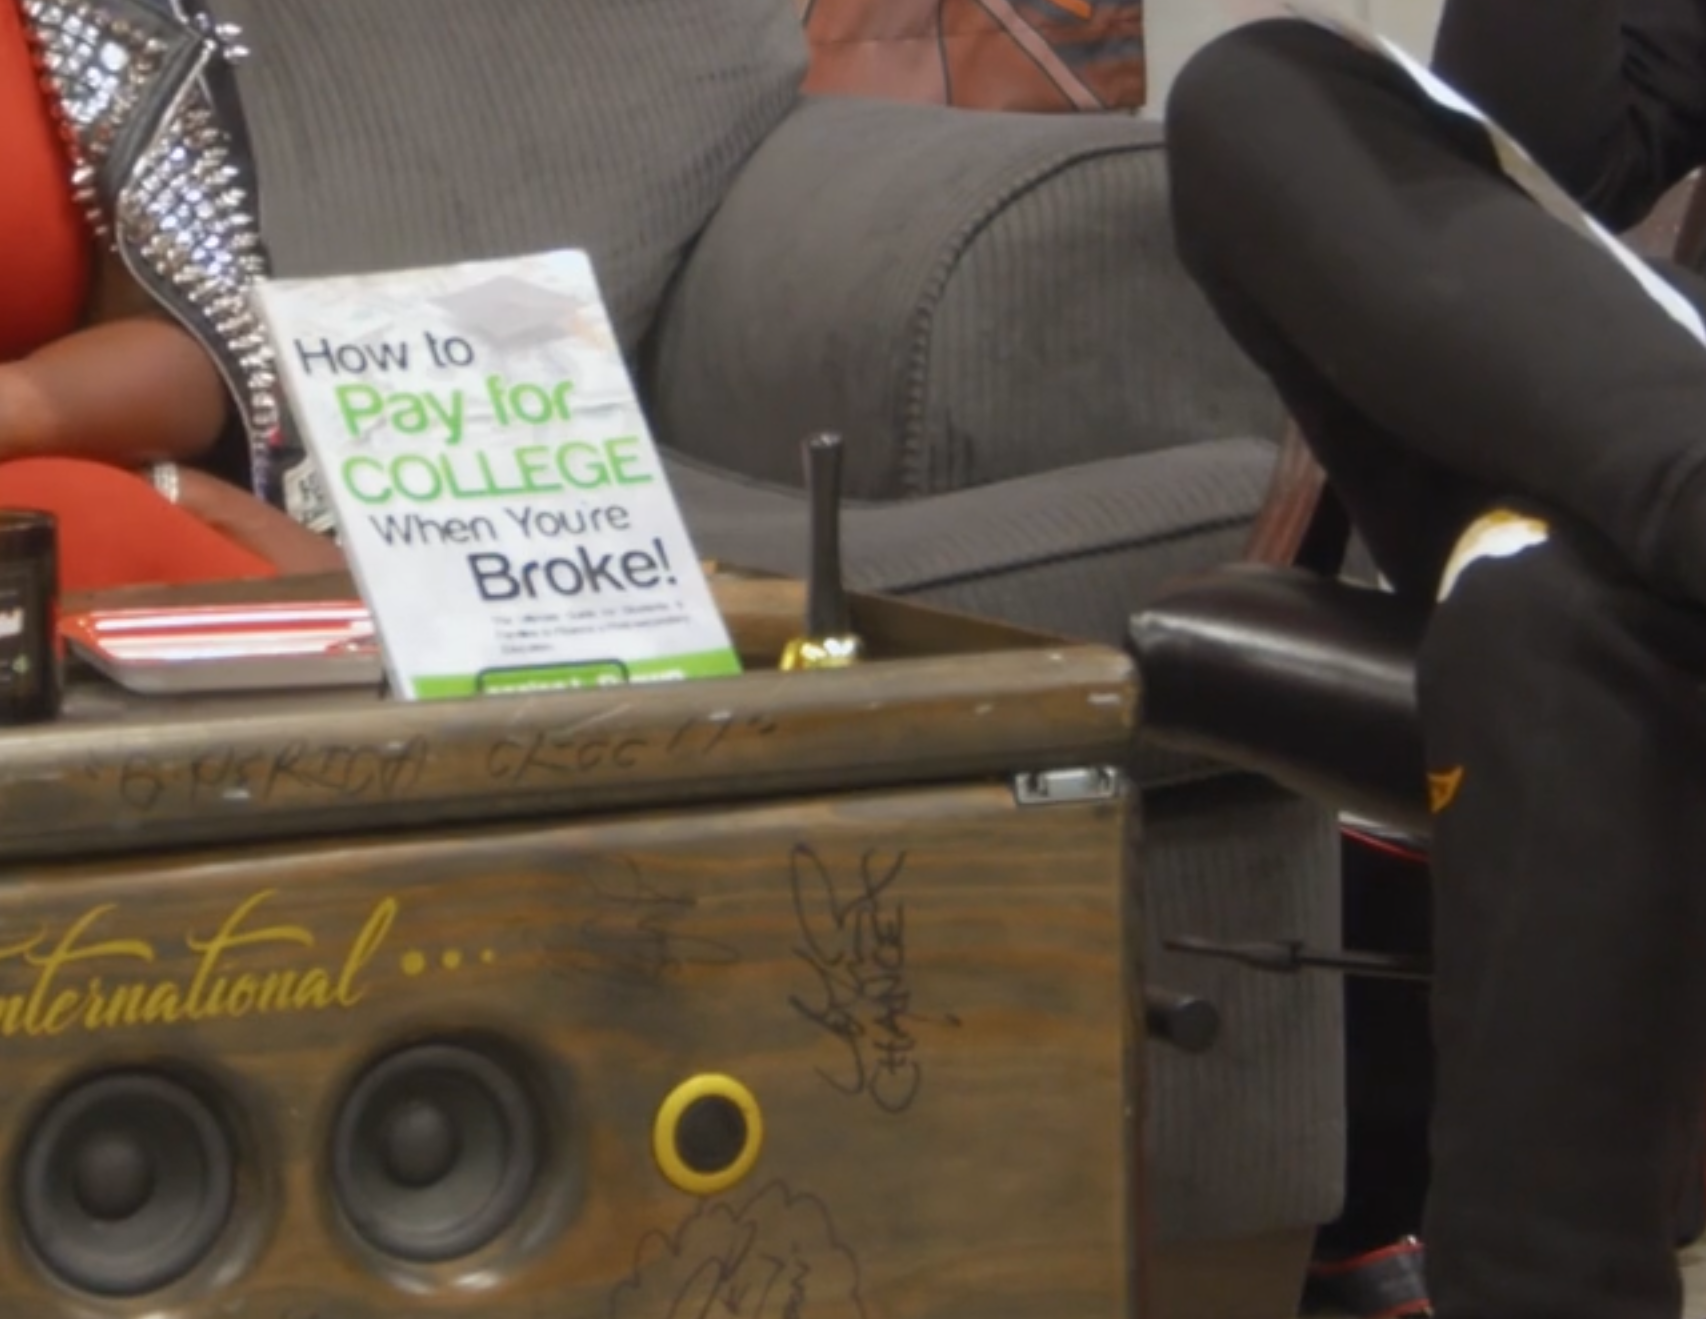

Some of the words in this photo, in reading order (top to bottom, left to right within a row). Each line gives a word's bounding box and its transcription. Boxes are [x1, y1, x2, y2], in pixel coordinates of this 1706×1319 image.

[293, 337, 409, 376] How
[423, 330, 476, 369] to
[333, 382, 463, 446] Pay
[486, 374, 575, 427] for
[340, 435, 654, 505] COLLEGE
[369, 513, 498, 548] When
[465, 536, 678, 605] Broke!
